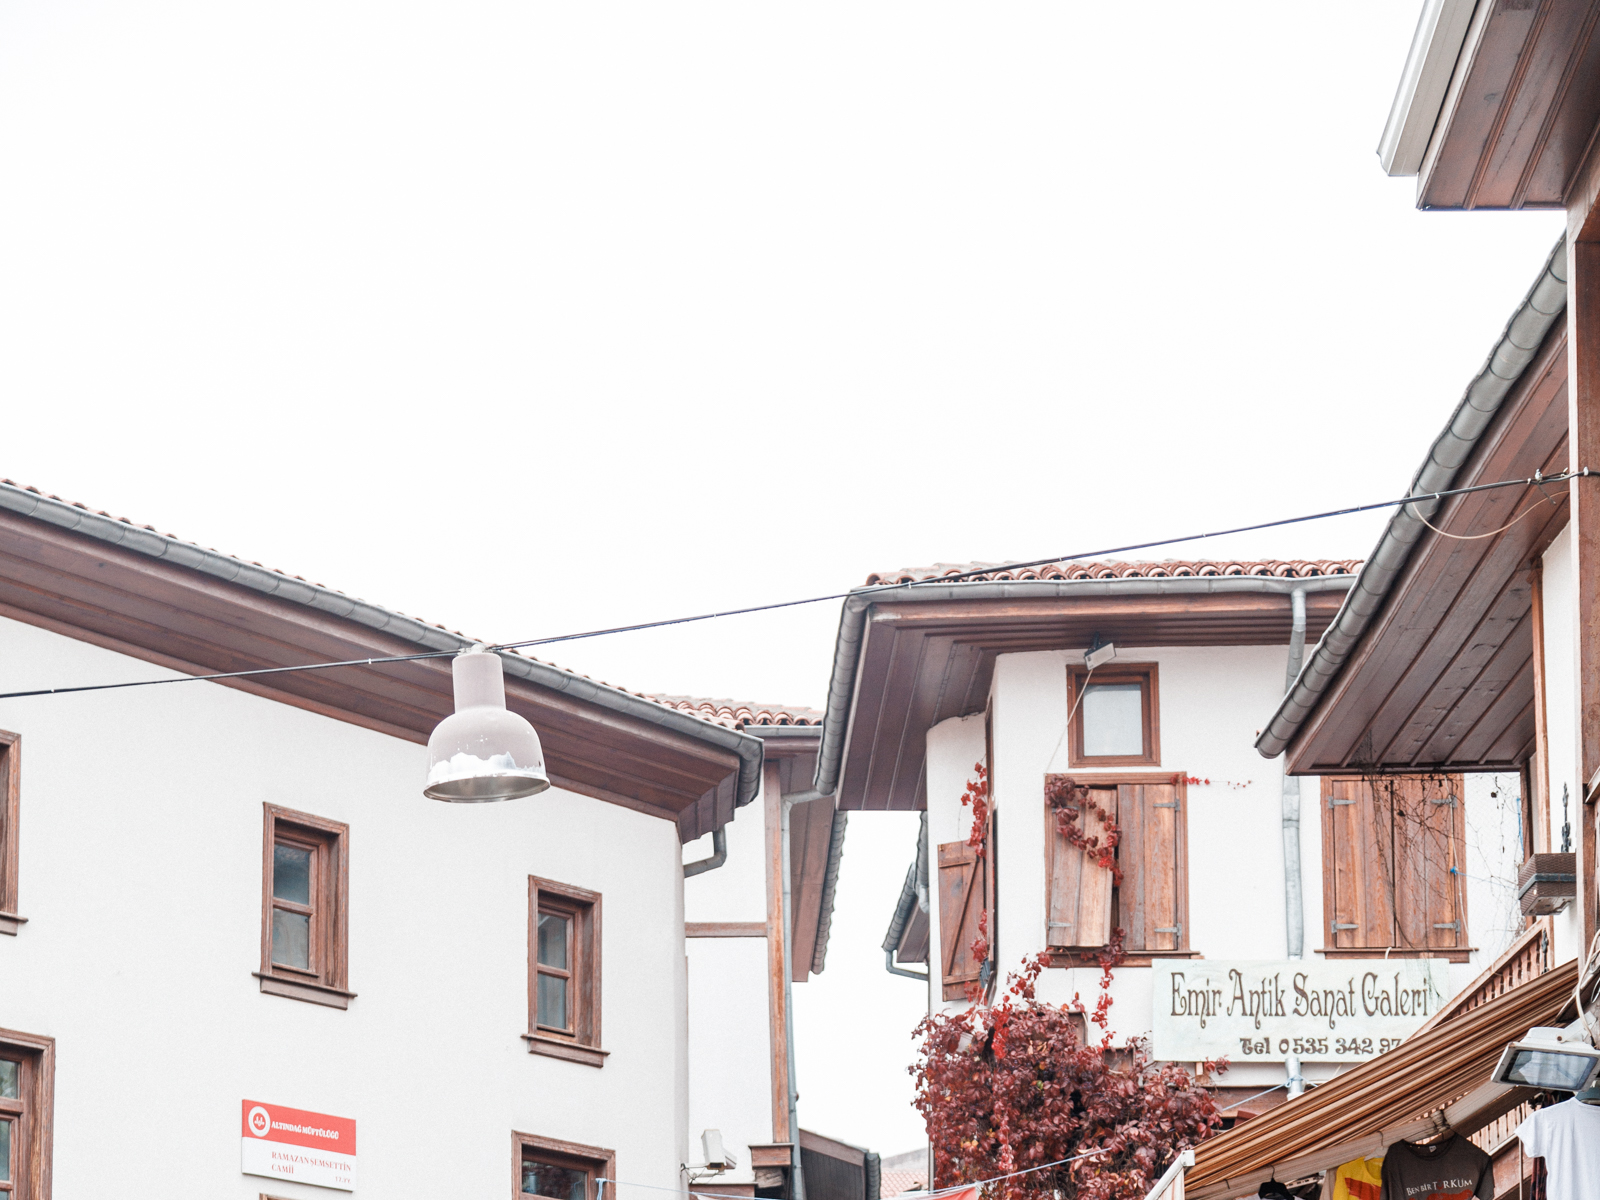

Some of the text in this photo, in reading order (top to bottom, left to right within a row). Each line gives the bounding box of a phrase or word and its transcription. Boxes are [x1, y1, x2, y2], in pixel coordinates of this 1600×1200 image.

[1170, 969, 1428, 1029] Emir Antik Sanat Galeri
[1240, 1038, 1270, 1054] Tel
[1336, 1038, 1374, 1054] 342
[272, 1152, 351, 1171] RAMAZAN ŞEMSETTİN
